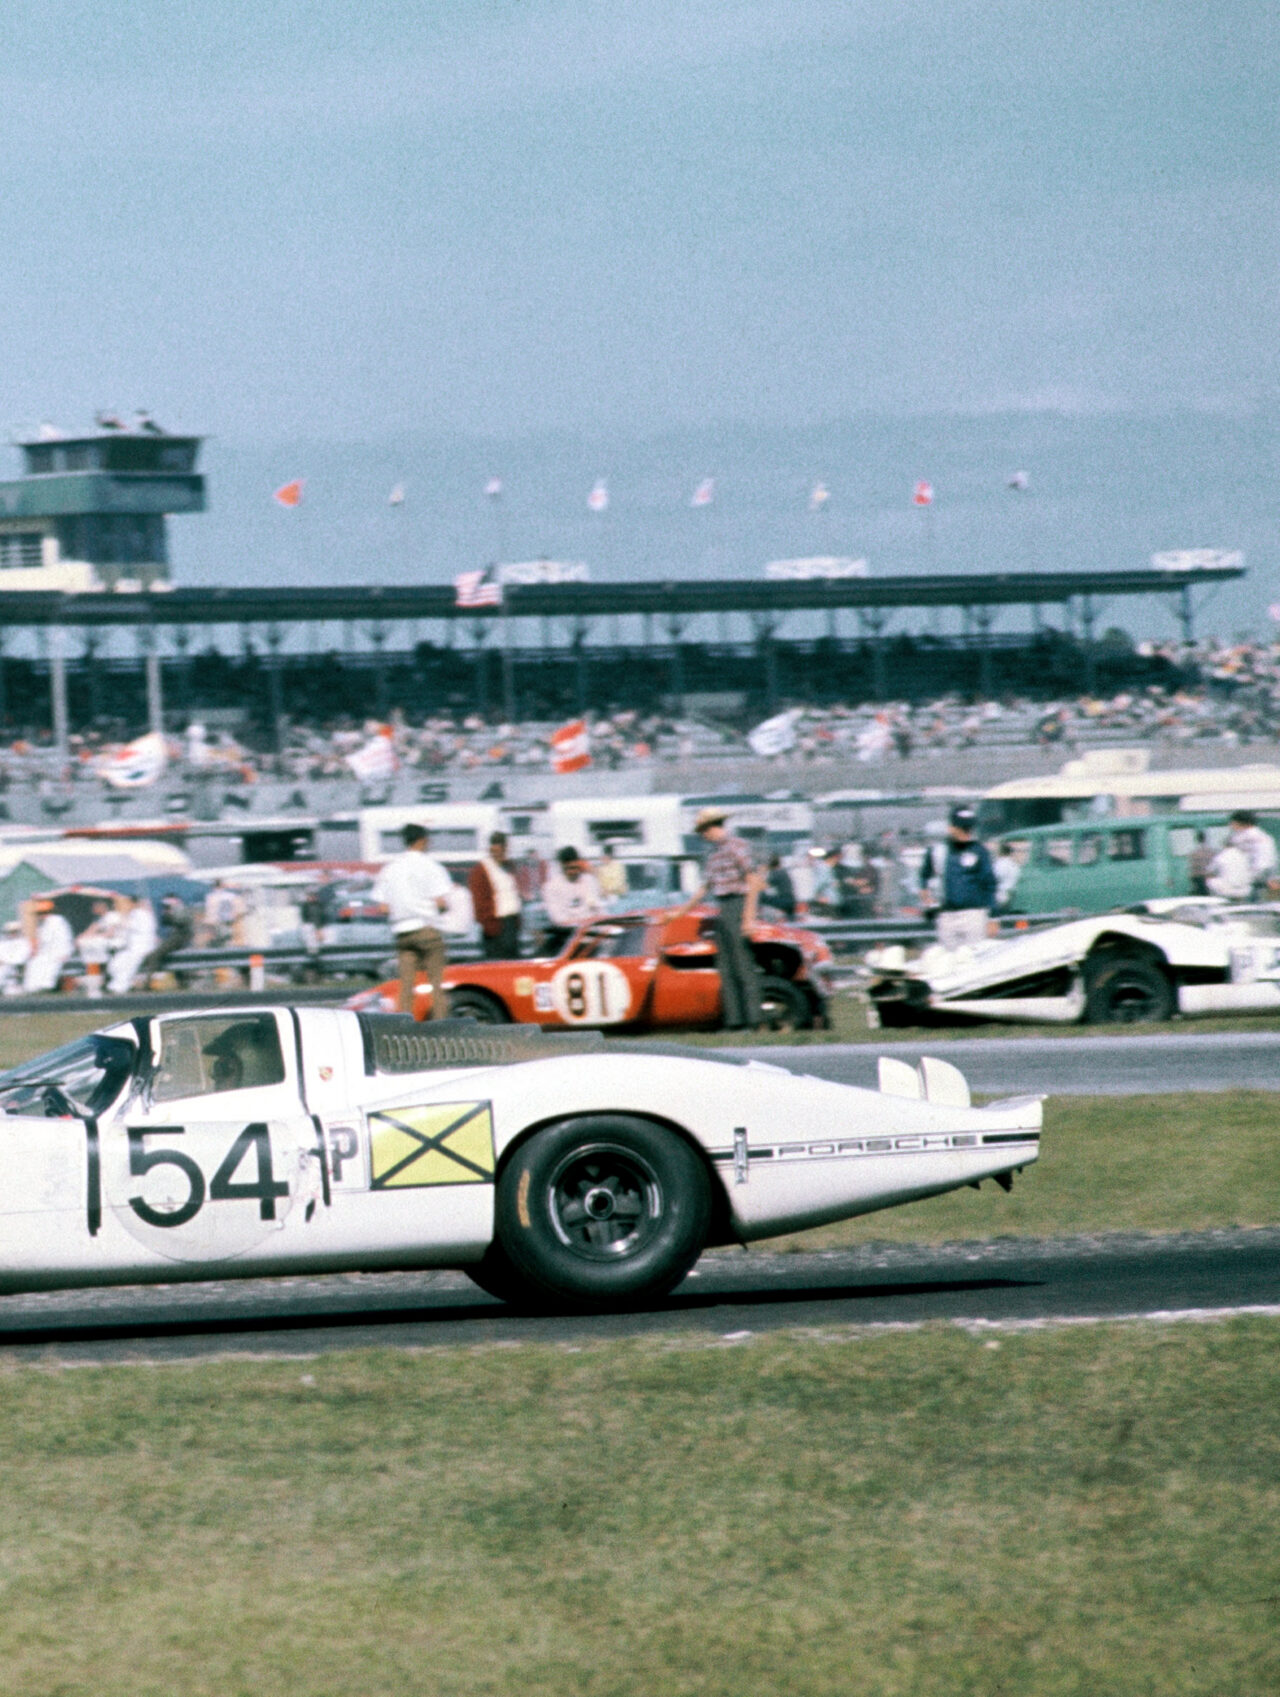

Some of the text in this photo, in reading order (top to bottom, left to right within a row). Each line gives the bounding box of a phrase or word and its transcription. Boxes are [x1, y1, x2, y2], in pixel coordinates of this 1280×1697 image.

[359, 781, 504, 806] USA
[568, 972, 608, 1018] 81
[778, 1135, 978, 1157] PORSCHE
[127, 1122, 289, 1228] 54
